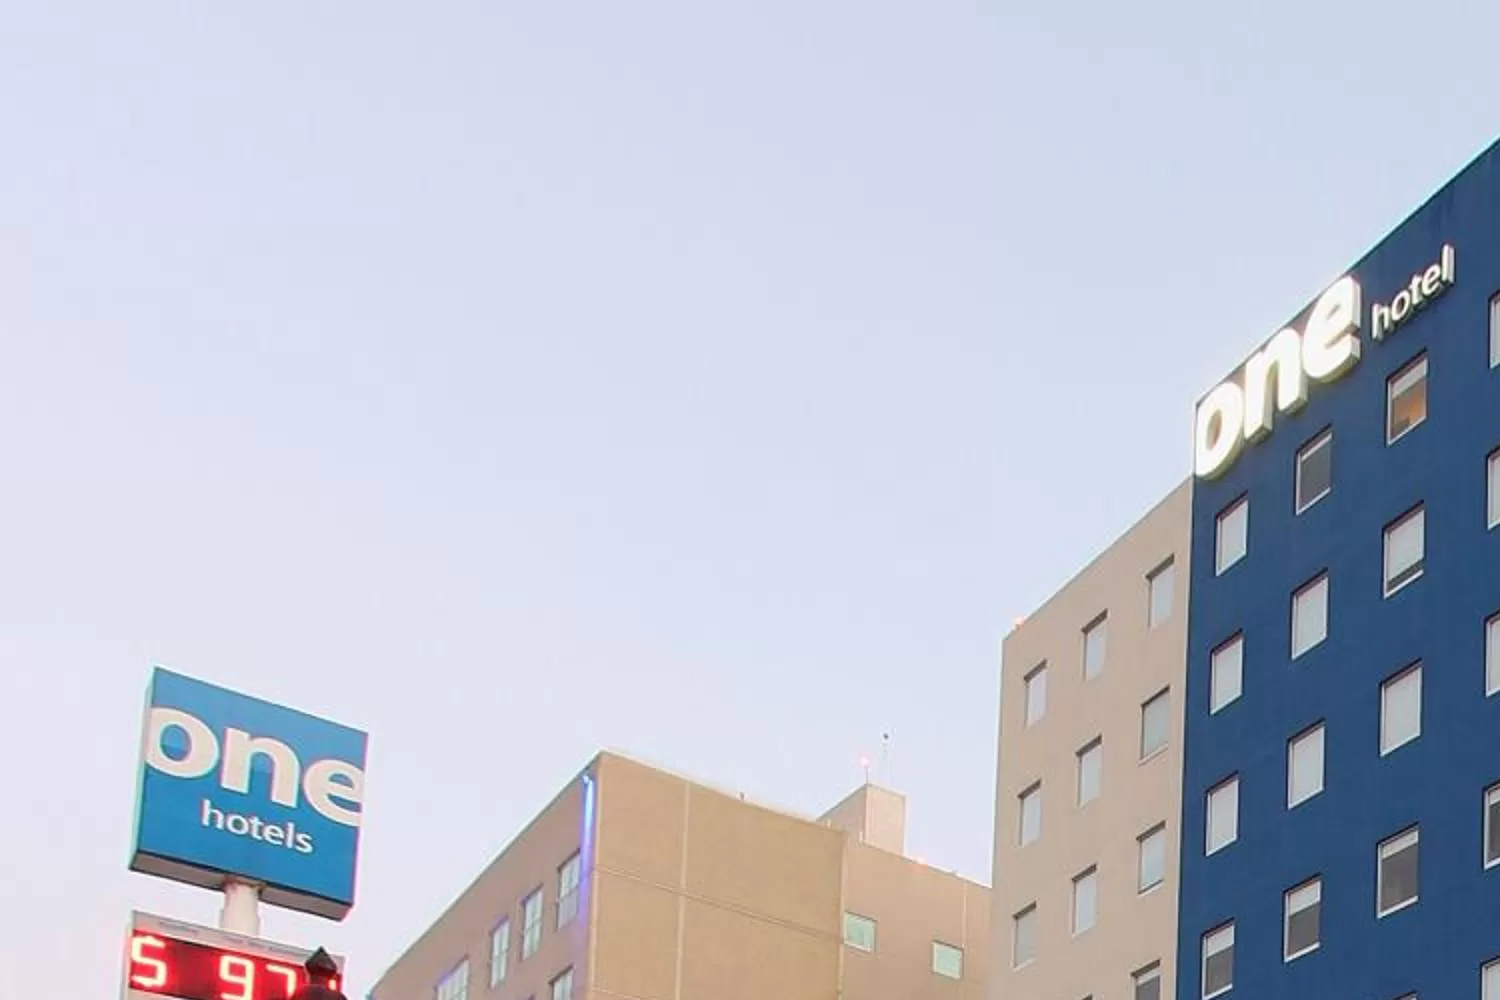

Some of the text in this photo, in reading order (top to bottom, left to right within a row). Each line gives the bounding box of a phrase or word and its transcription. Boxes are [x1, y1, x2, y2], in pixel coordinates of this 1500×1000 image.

[1195, 242, 1456, 480] one hotel
[144, 706, 363, 826] one
[201, 799, 314, 853] hotels
